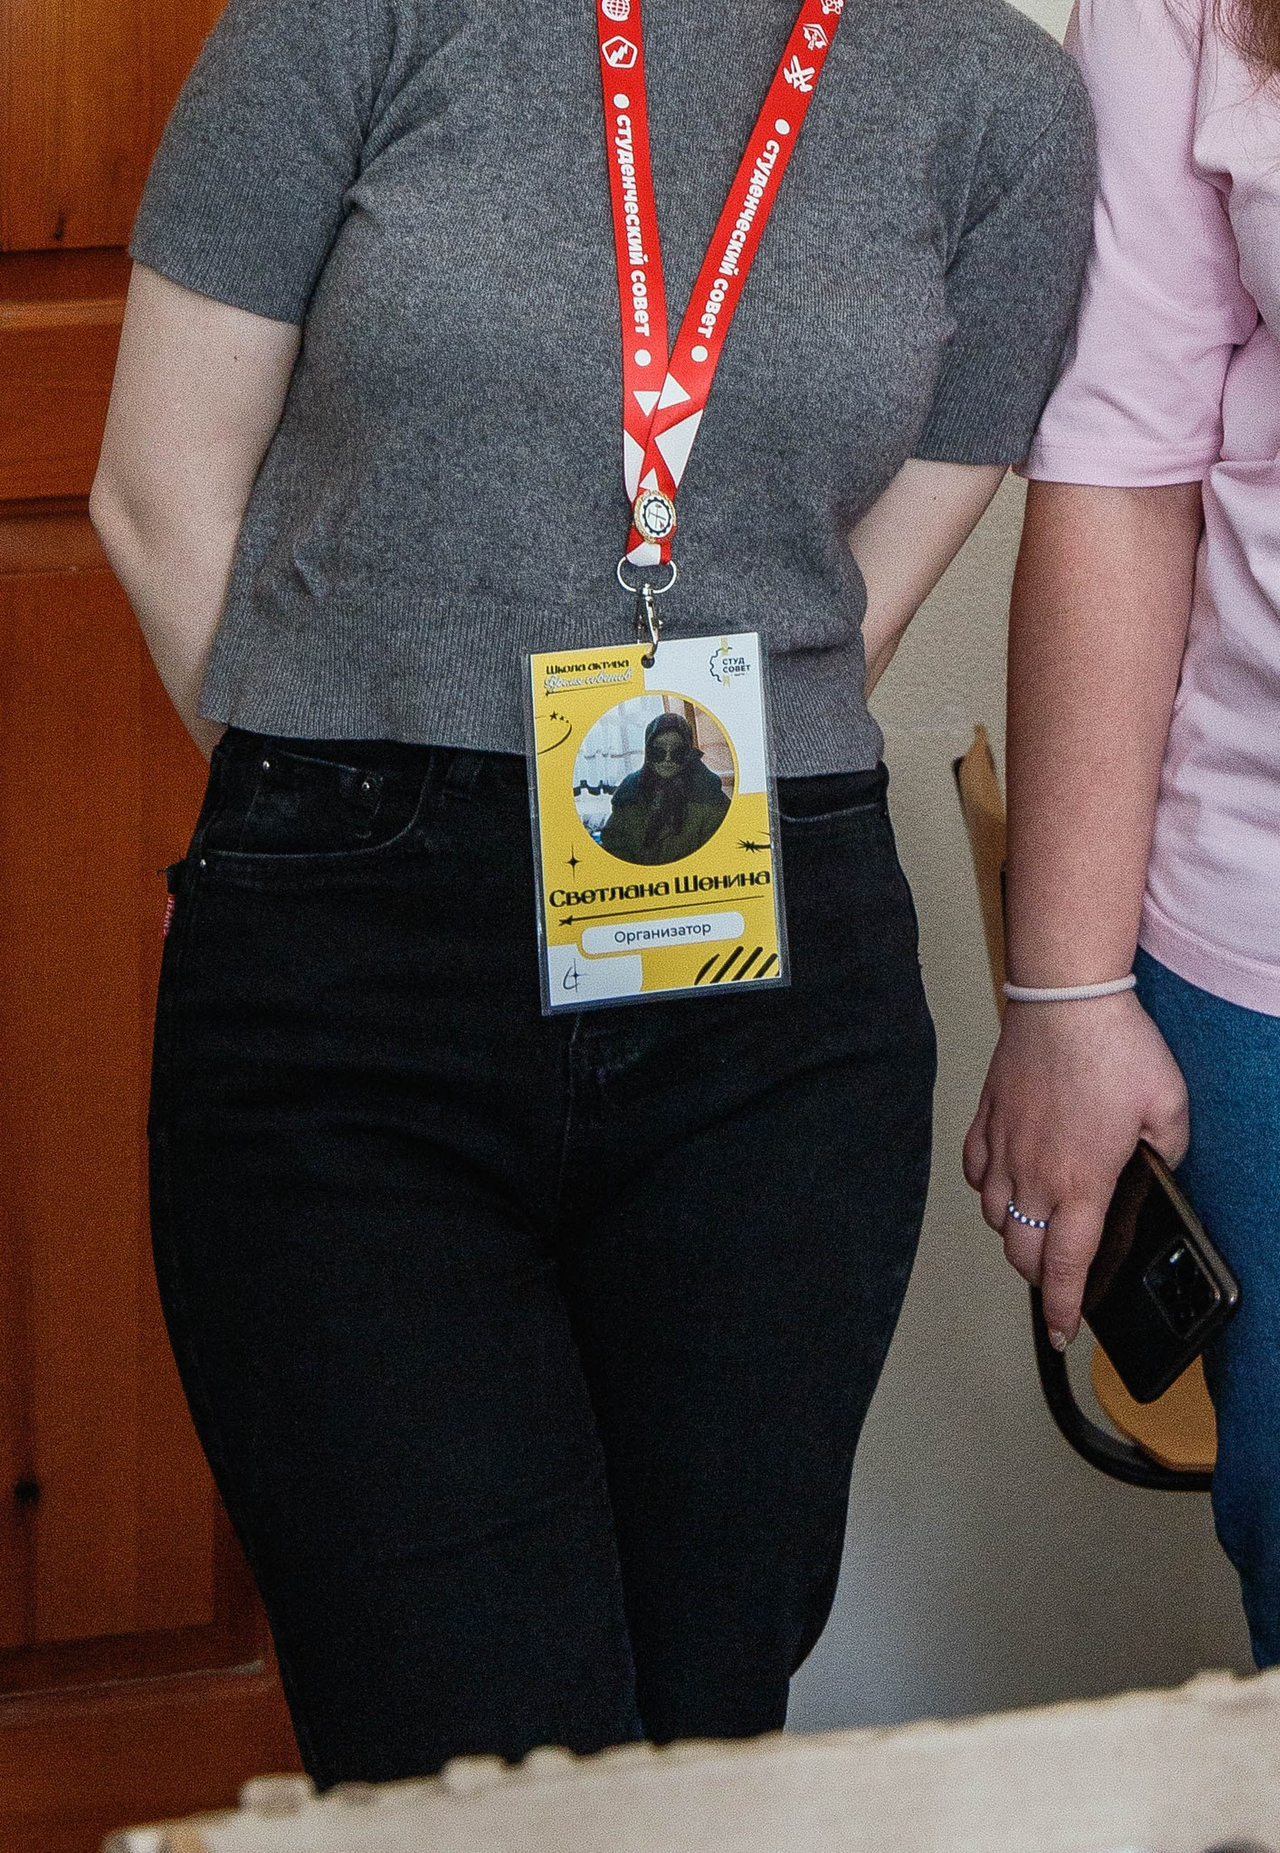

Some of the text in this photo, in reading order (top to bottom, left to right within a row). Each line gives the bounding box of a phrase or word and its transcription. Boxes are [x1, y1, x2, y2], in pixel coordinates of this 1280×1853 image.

[722, 657, 745, 666] СТУД
[722, 664, 751, 674] СОВЕТ
[549, 870, 771, 908] Светлана Шенина
[614, 922, 712, 945] Организатор
